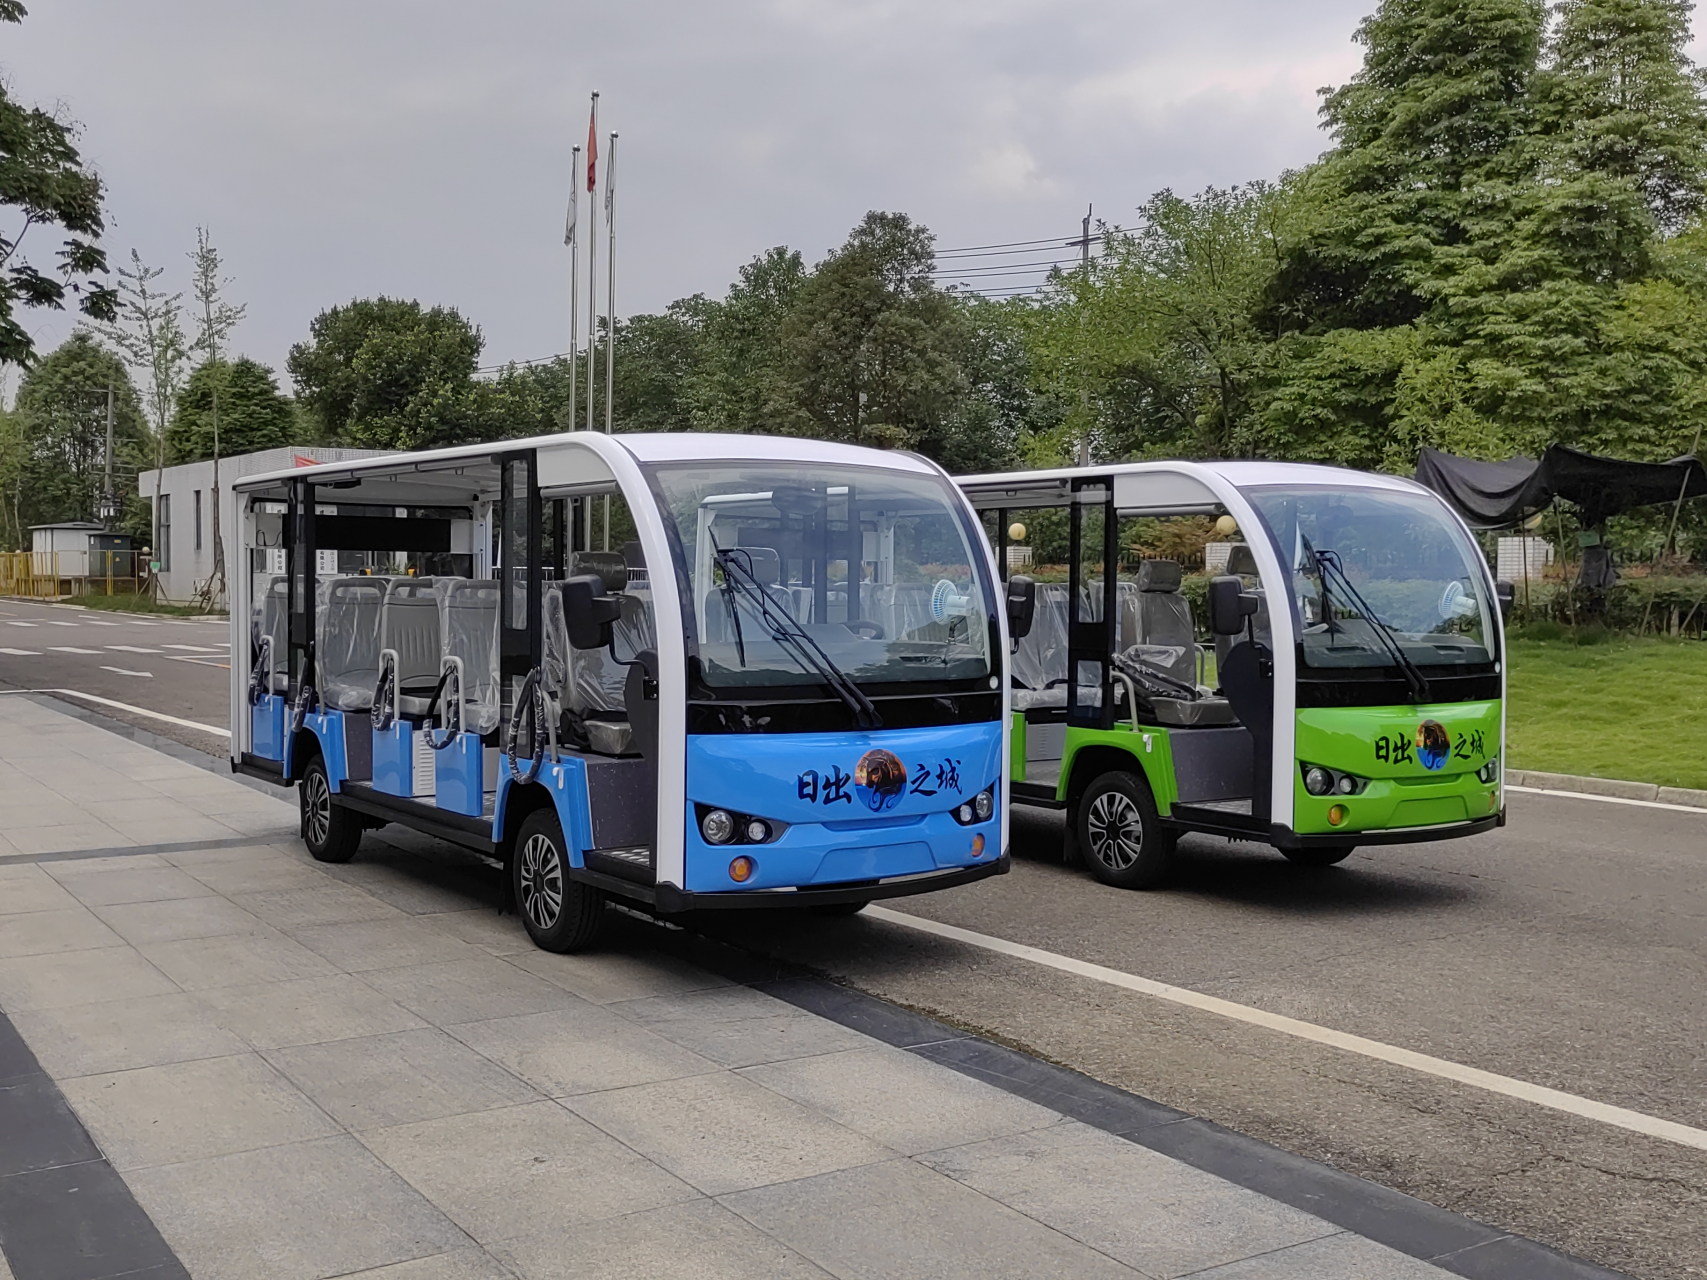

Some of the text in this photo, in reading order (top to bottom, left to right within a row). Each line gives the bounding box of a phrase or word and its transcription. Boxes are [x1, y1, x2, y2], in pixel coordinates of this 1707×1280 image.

[1374, 729, 1486, 765] 日出 之城
[797, 757, 963, 806] 日出 之城
